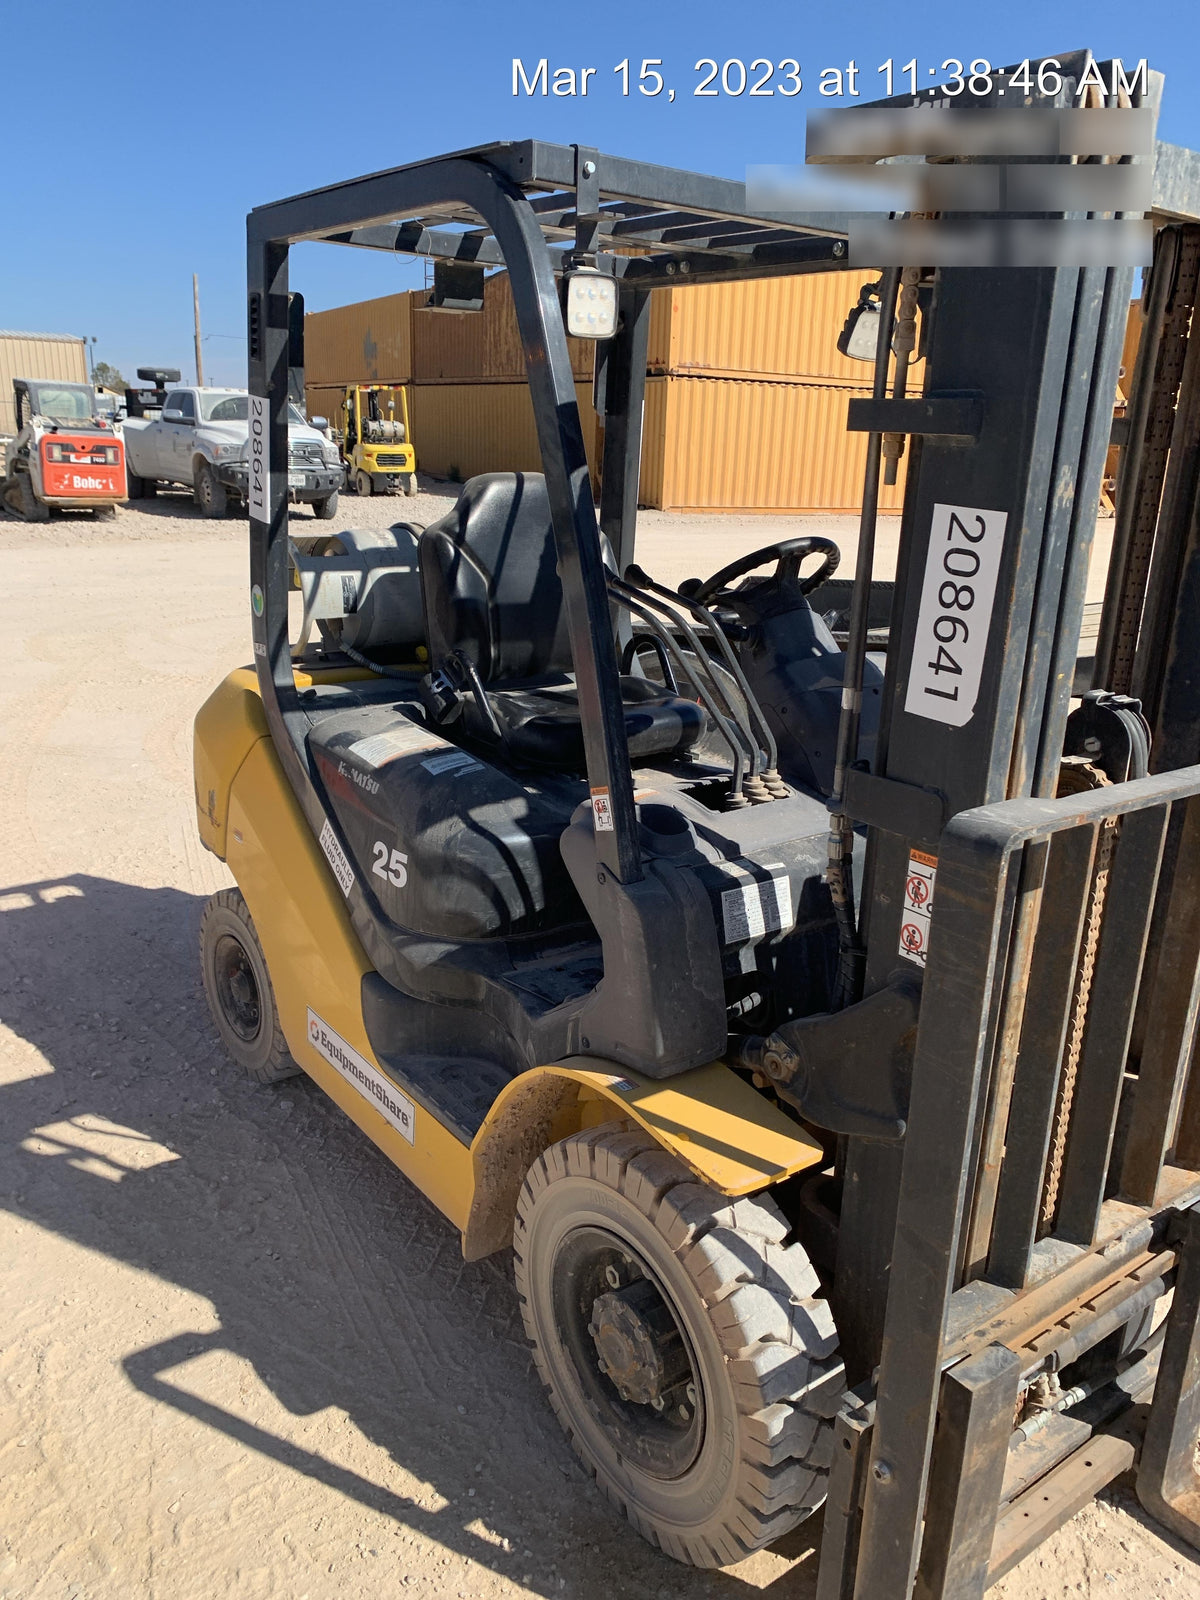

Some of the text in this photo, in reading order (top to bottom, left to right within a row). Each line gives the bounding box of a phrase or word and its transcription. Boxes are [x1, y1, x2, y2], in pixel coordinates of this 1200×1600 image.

[73, 475, 114, 490] Bobct
[252, 399, 263, 509] 208641
[924, 511, 987, 702] 208641
[338, 760, 380, 795] KMATSU
[320, 836, 351, 891] FLUID ONLY
[323, 822, 354, 884] HYDRAULIC
[371, 840, 409, 888] 25
[320, 1030, 410, 1128] EquipmentShare
